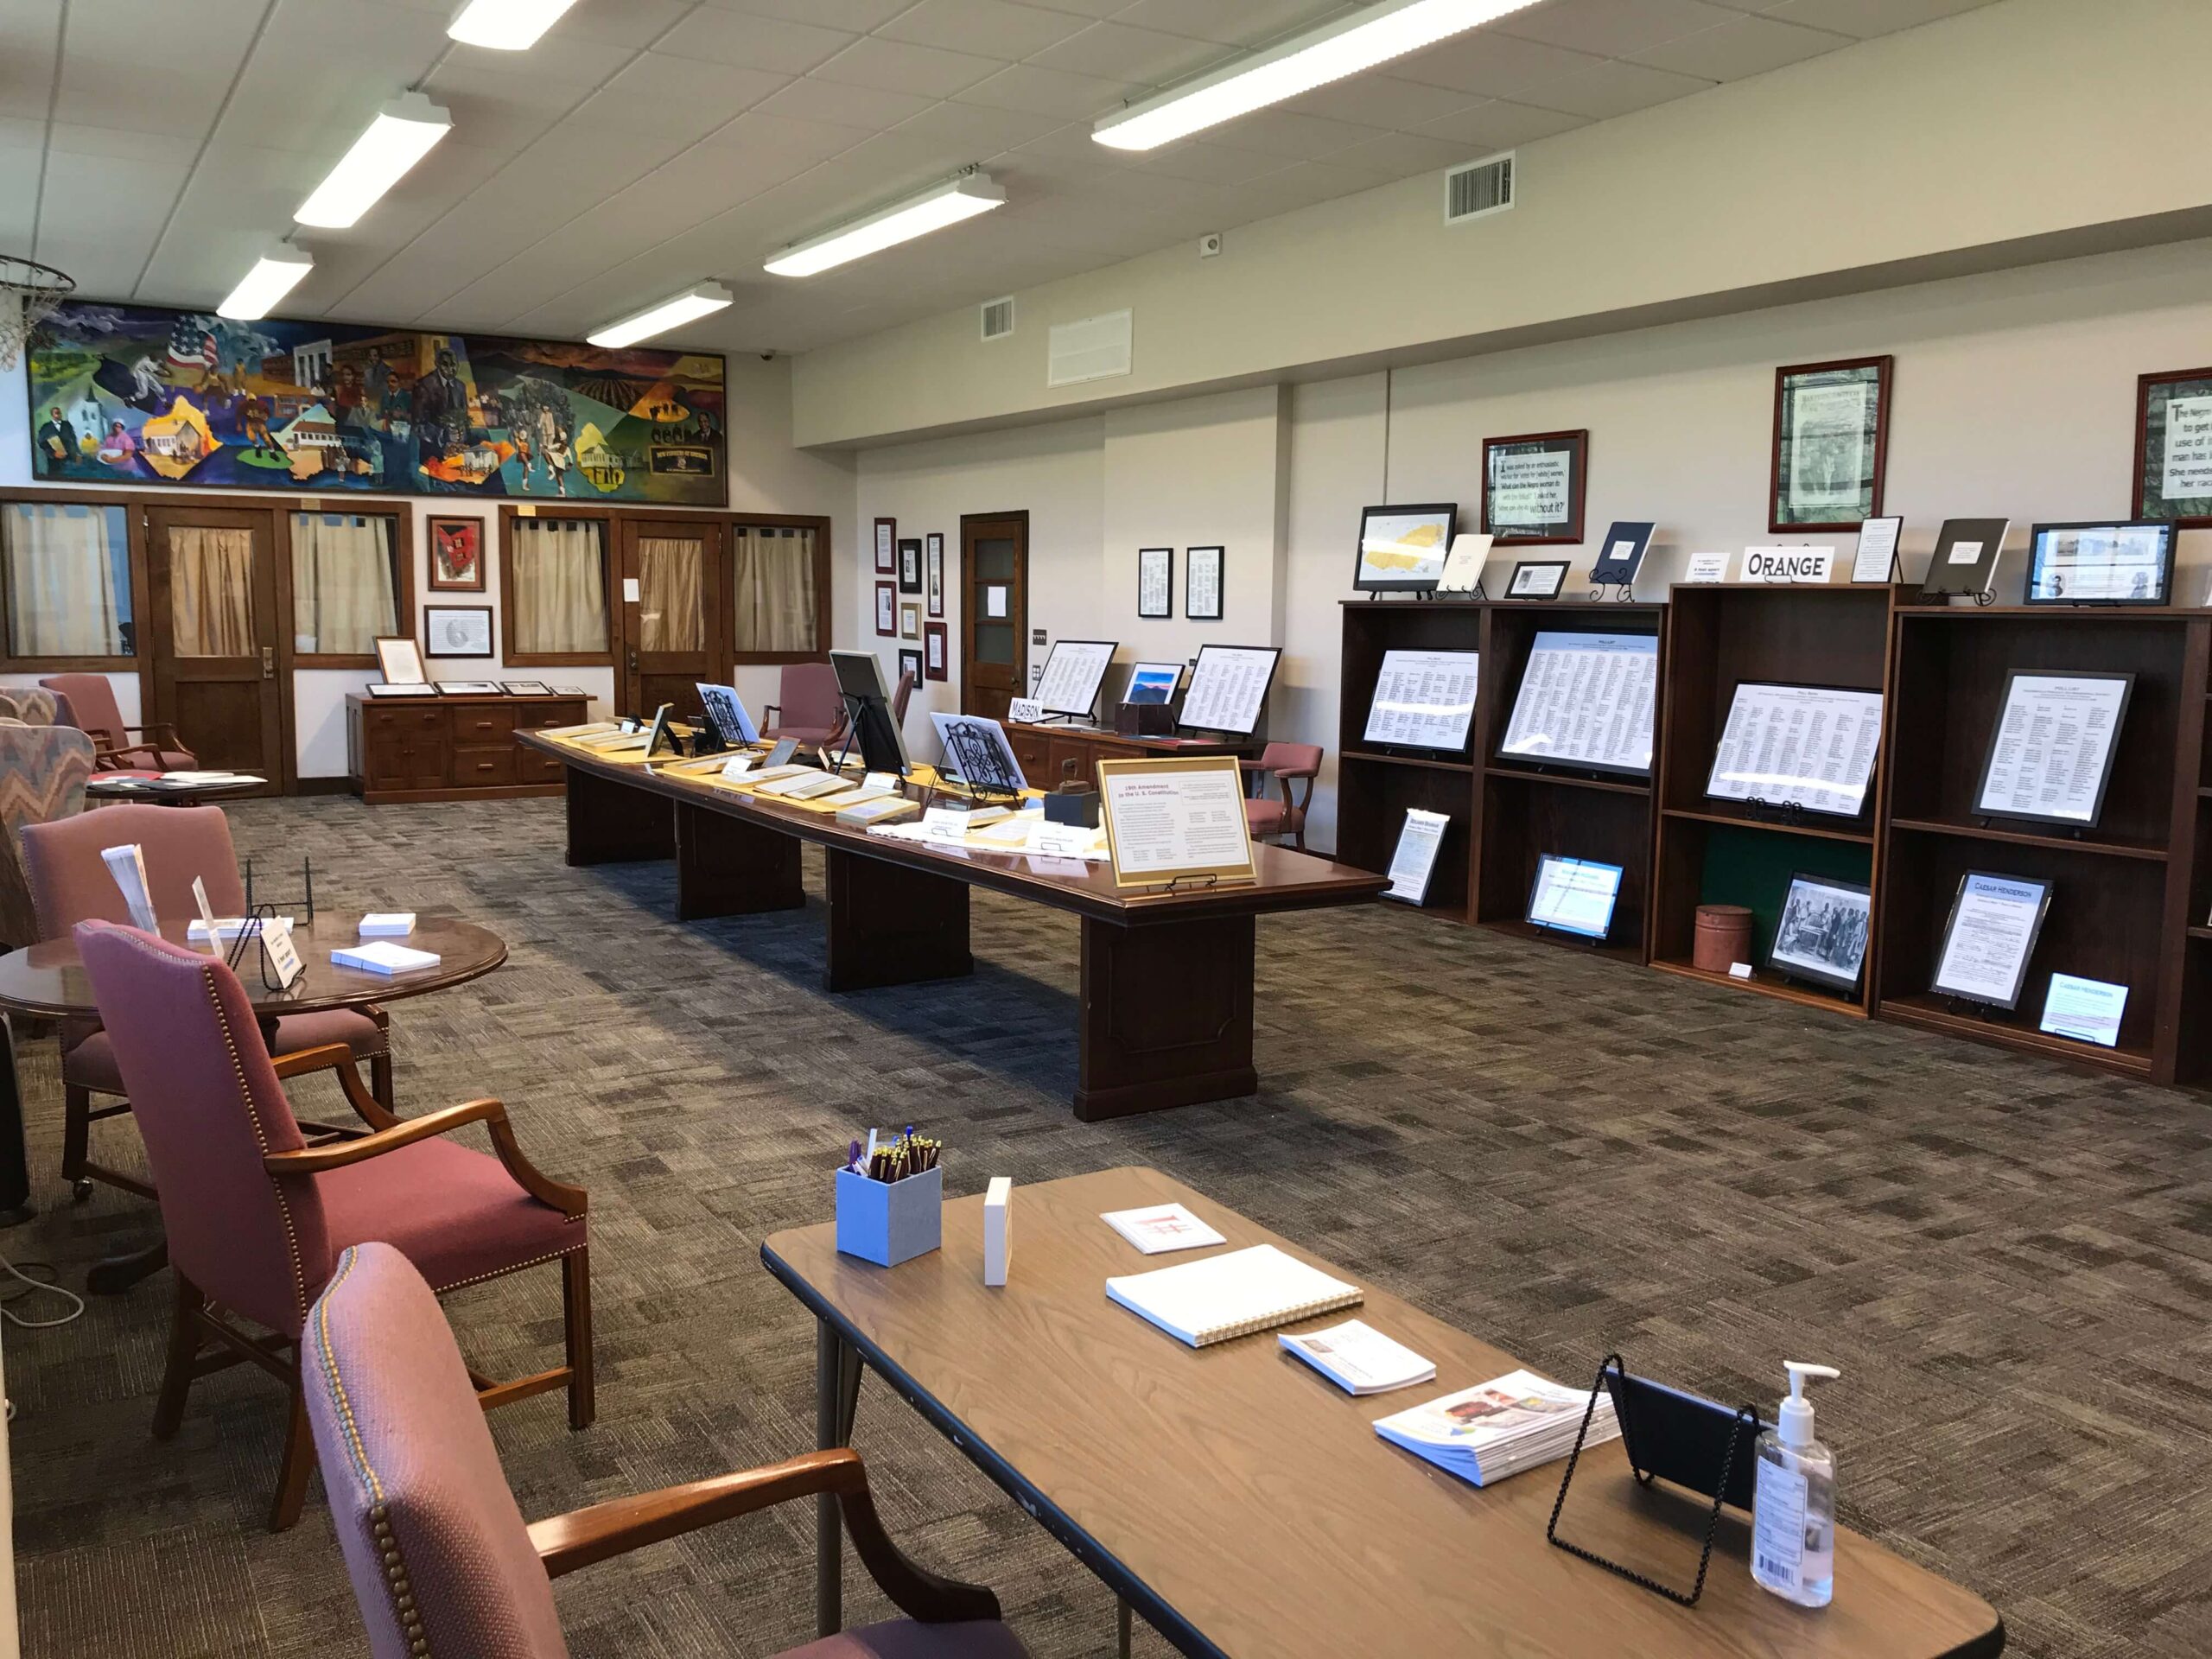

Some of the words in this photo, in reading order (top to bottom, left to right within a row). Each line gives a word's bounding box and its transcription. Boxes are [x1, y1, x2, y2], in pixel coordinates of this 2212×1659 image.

[2171, 404, 2188, 422] The
[2195, 423, 2209, 433] get
[2175, 439, 2192, 448] use
[2195, 436, 2205, 446] of
[2192, 452, 2207, 461] has
[2169, 468, 2185, 477] She
[1529, 502, 1554, 513] without
[1747, 553, 1825, 576] ORANGE
[1012, 701, 1039, 717] MADISON
[1974, 882, 1997, 892] CAESAR
[1998, 886, 2033, 898] HENDERSON
